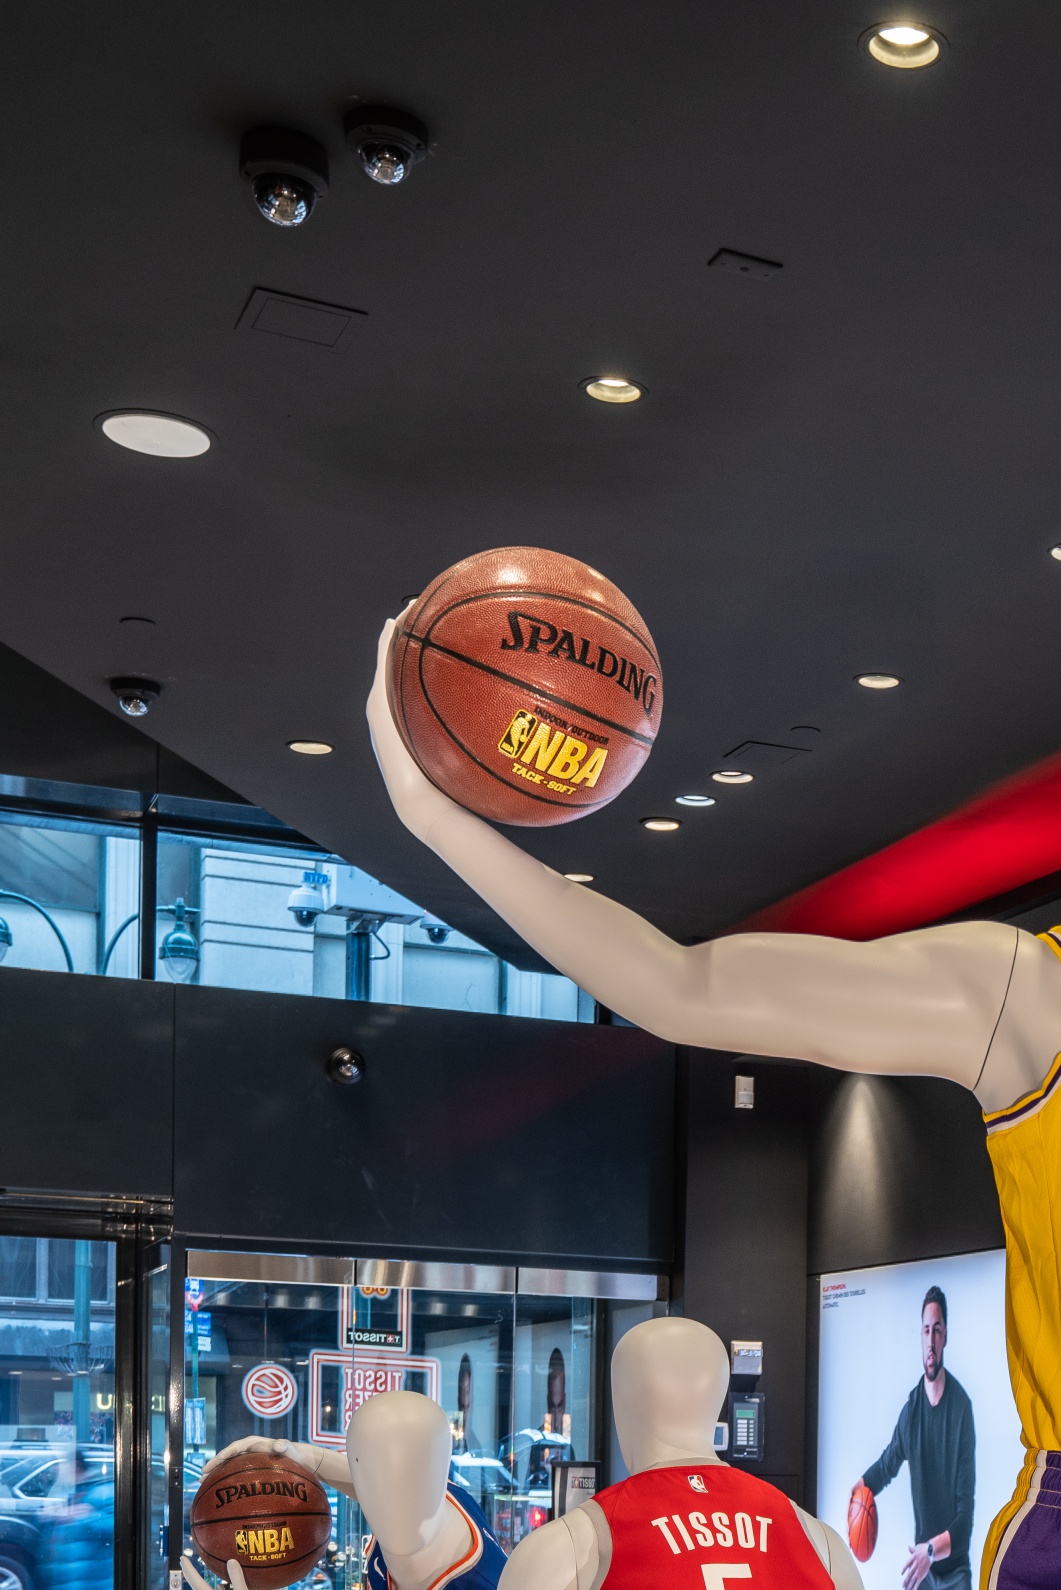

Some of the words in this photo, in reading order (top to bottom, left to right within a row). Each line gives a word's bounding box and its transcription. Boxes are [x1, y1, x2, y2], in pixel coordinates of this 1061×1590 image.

[501, 610, 657, 716] SPALDING
[534, 706, 610, 745] INDOOR/OUTDOOR
[520, 722, 608, 788] NBA
[304, 871, 329, 884] NYPD
[215, 1481, 308, 1509] SPALDING
[248, 1527, 295, 1554] NBA
[651, 1512, 773, 1554] TISSOT
